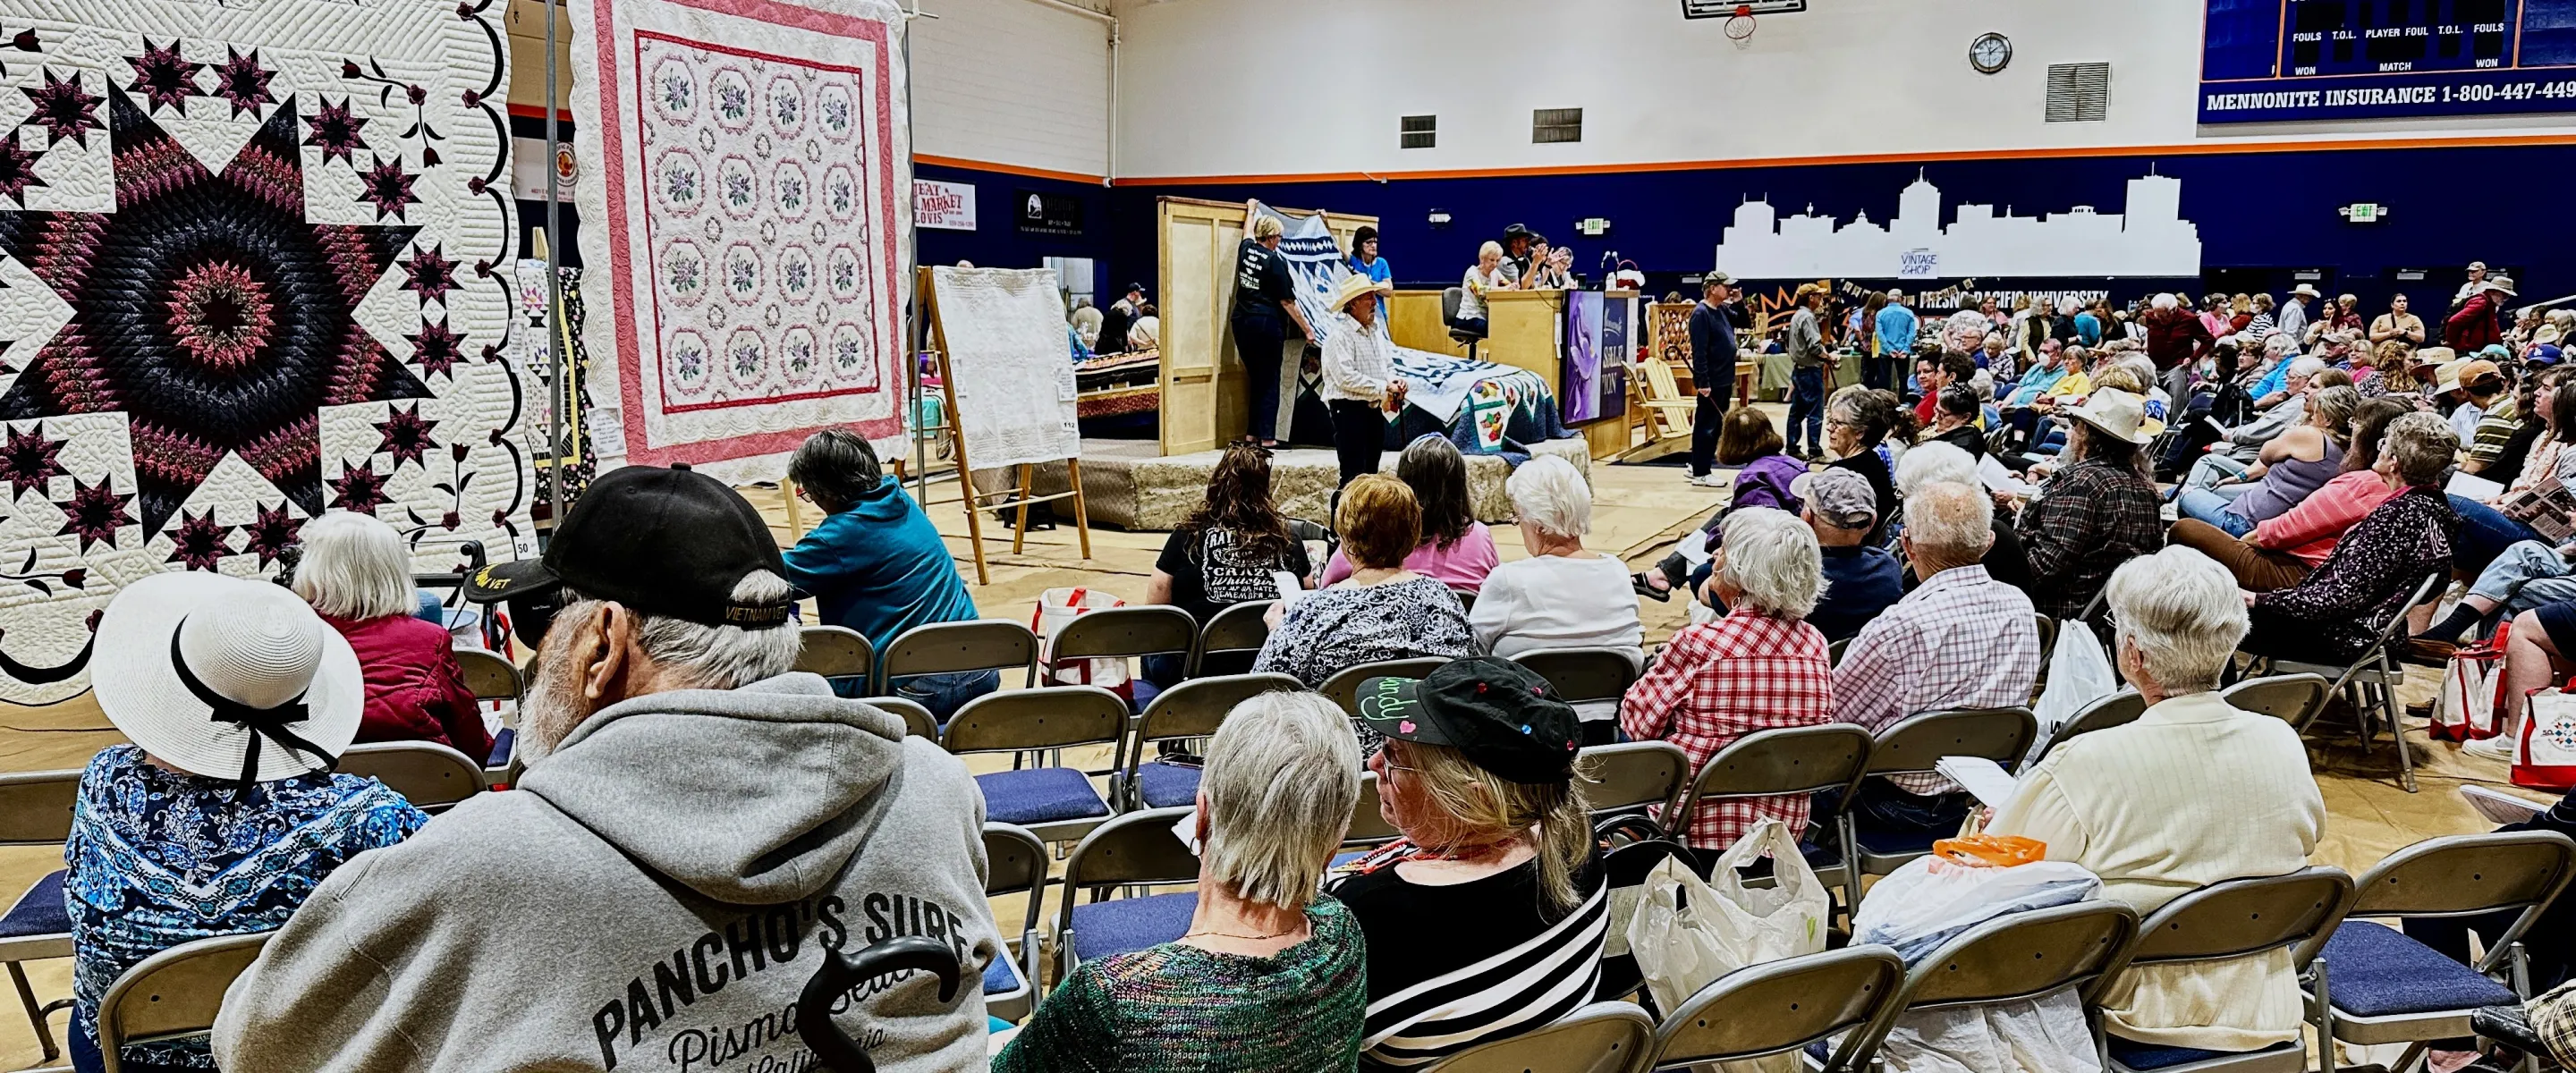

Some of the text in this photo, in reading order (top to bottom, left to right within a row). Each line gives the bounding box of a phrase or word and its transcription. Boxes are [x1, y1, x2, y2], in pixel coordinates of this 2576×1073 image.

[2292, 23, 2504, 42] FOULS T.O.L. PLAYER FOUL T.O.L. FOULS
[2295, 58, 2498, 76] WON MATCH WON
[2207, 90, 2320, 111] MENNONITE
[2325, 86, 2436, 106] INSURANCE
[921, 188, 963, 214] MARKET
[1901, 254, 1937, 265] VINTAGE
[1901, 265, 1931, 275] SHOP
[1604, 345, 1623, 368] SALE
[518, 543, 529, 553] 50
[488, 579, 512, 589] VET
[726, 605, 788, 621] VIETNAM VET
[592, 891, 969, 1072] PANCHO'S SURF
[668, 1001, 799, 1073] Pismo
